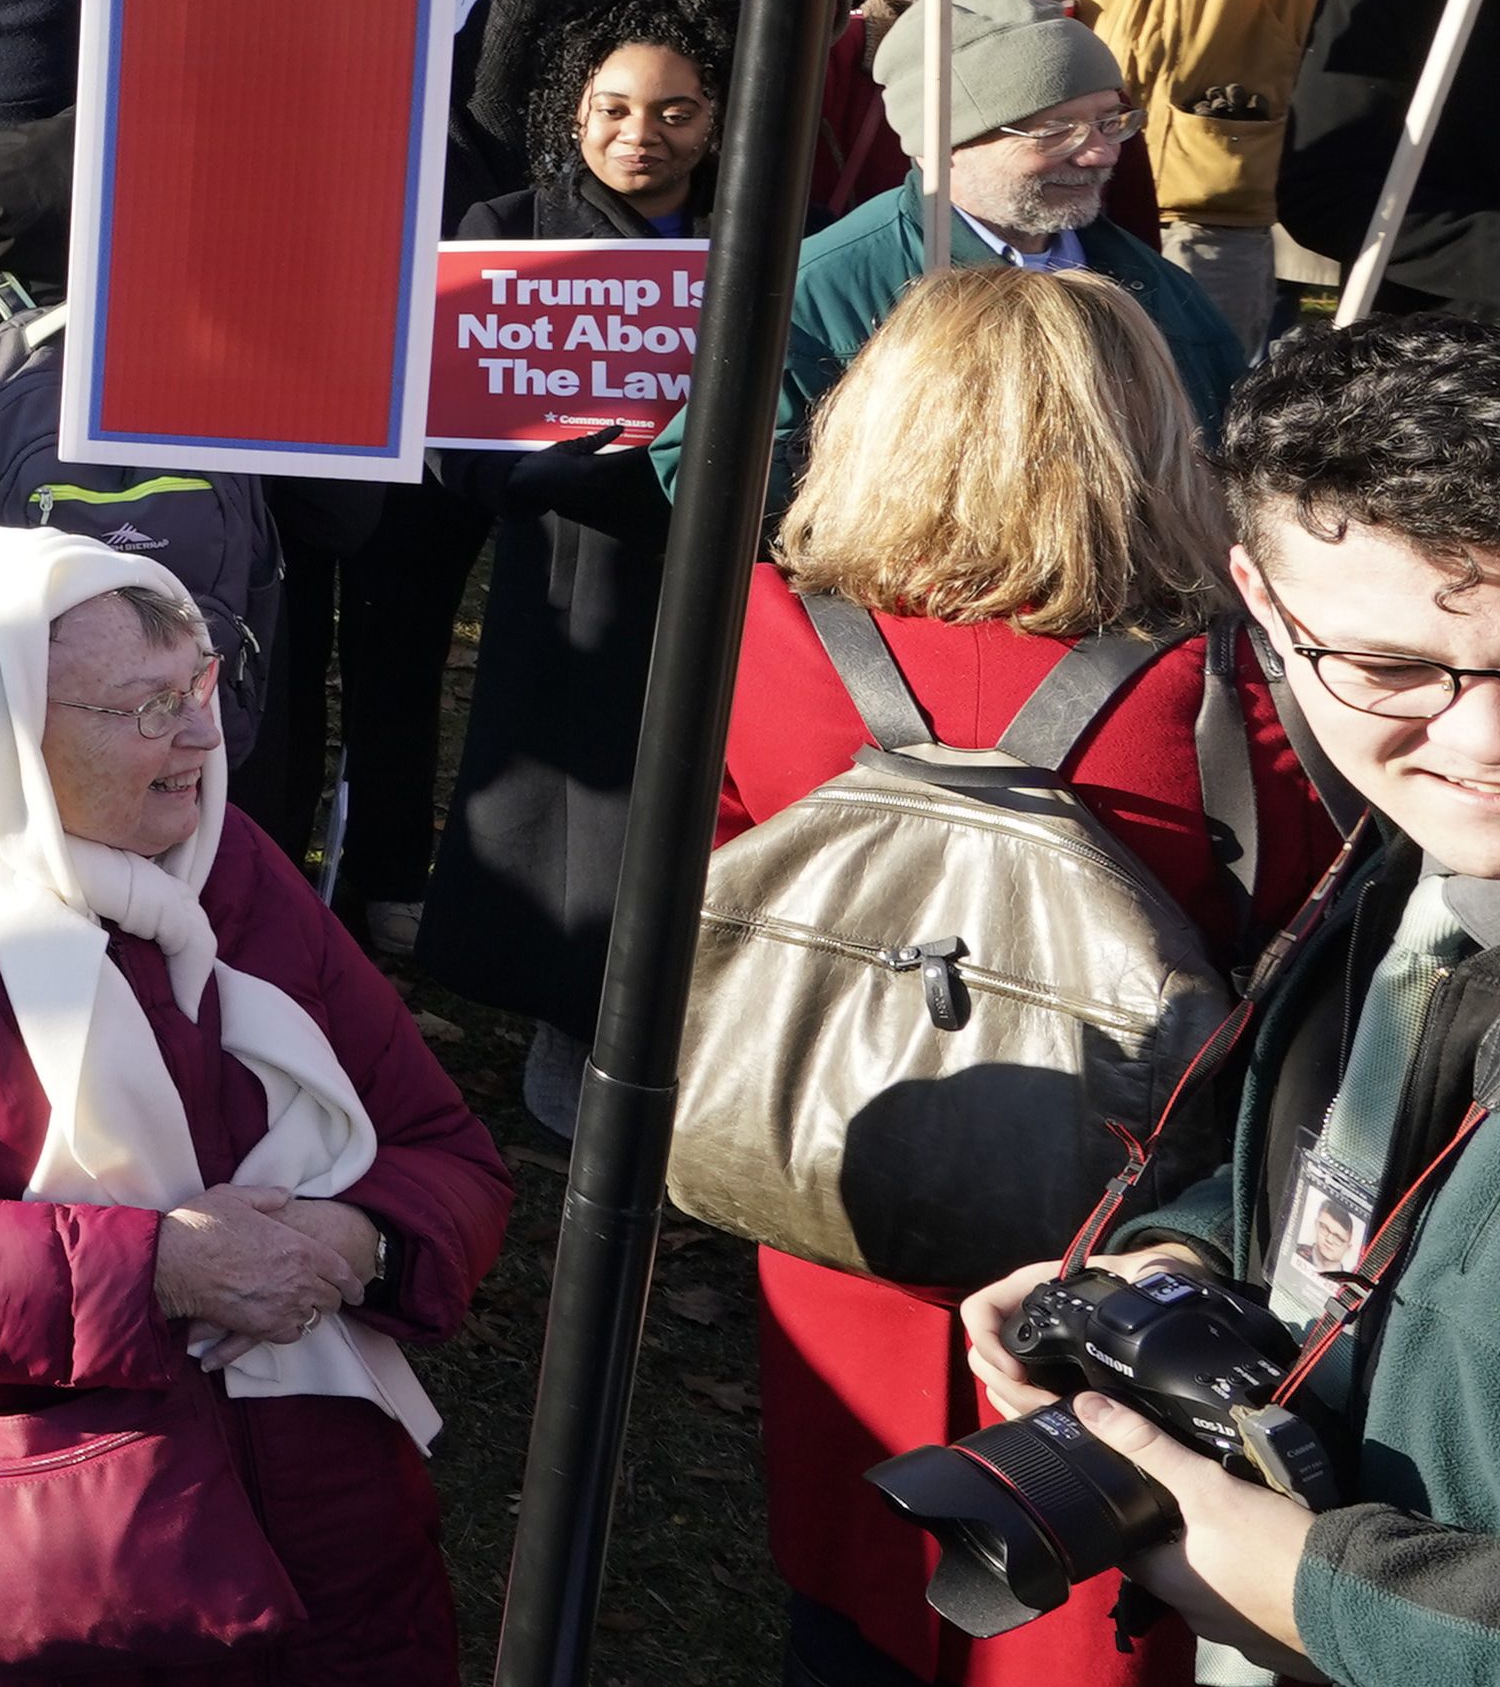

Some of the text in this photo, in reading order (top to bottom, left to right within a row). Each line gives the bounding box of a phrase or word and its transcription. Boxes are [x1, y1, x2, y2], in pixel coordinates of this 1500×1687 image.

[481, 269, 660, 315] Trump
[457, 314, 553, 350] Not
[478, 358, 580, 396] The
[559, 414, 655, 429] Common Cause
[1085, 1340, 1135, 1379] Canon
